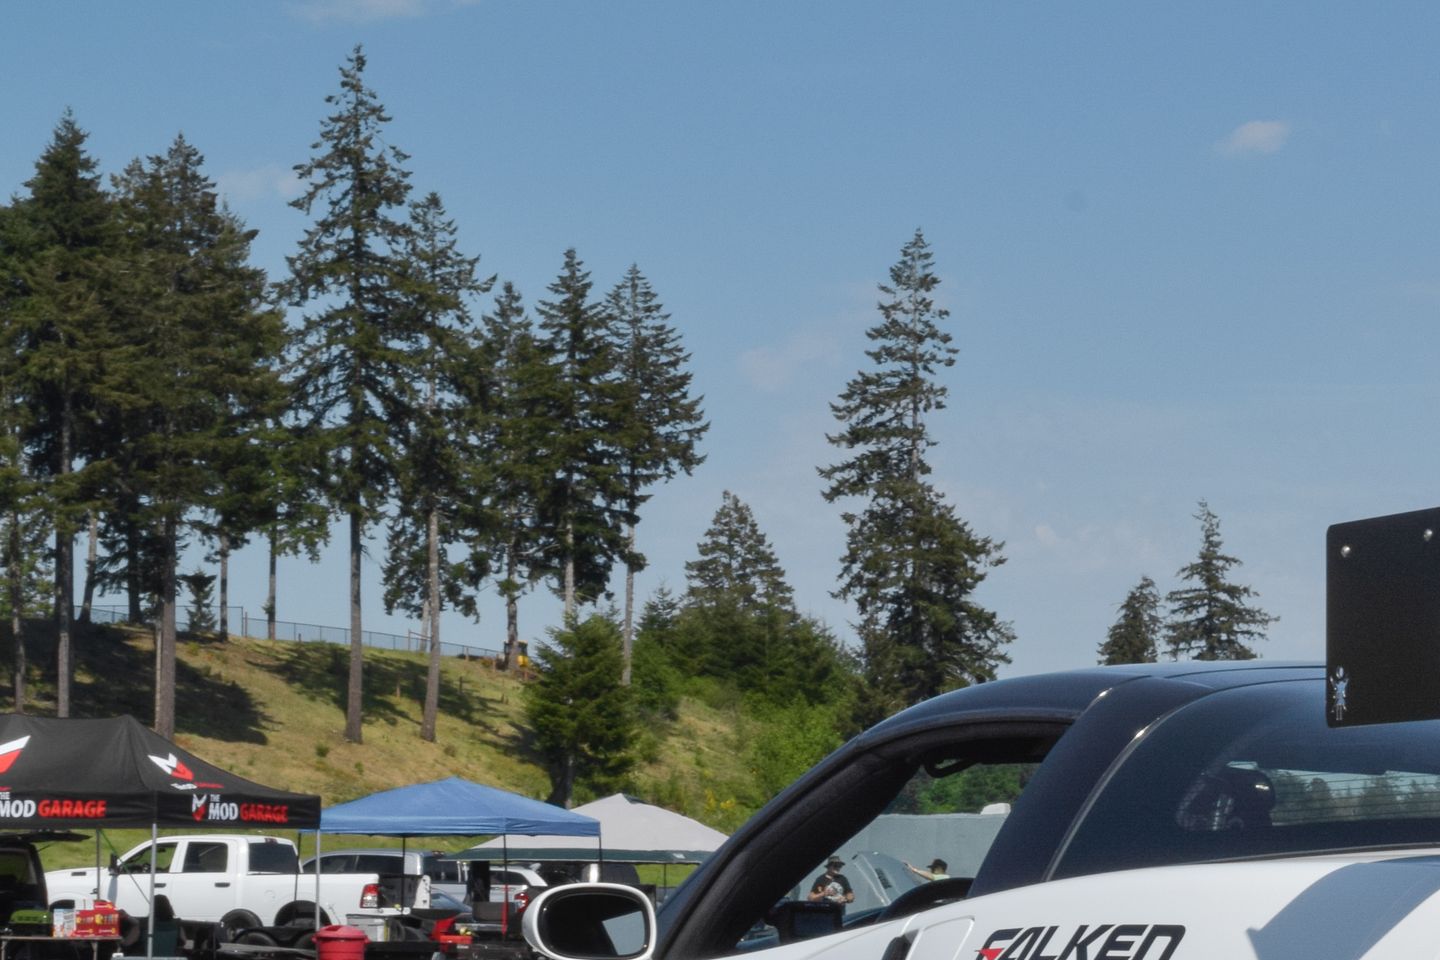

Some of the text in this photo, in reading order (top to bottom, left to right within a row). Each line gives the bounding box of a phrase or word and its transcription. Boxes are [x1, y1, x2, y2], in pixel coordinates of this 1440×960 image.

[210, 794, 221, 802] THE
[37, 799, 107, 818] GARAGE
[208, 802, 289, 824] MOD GARAGE
